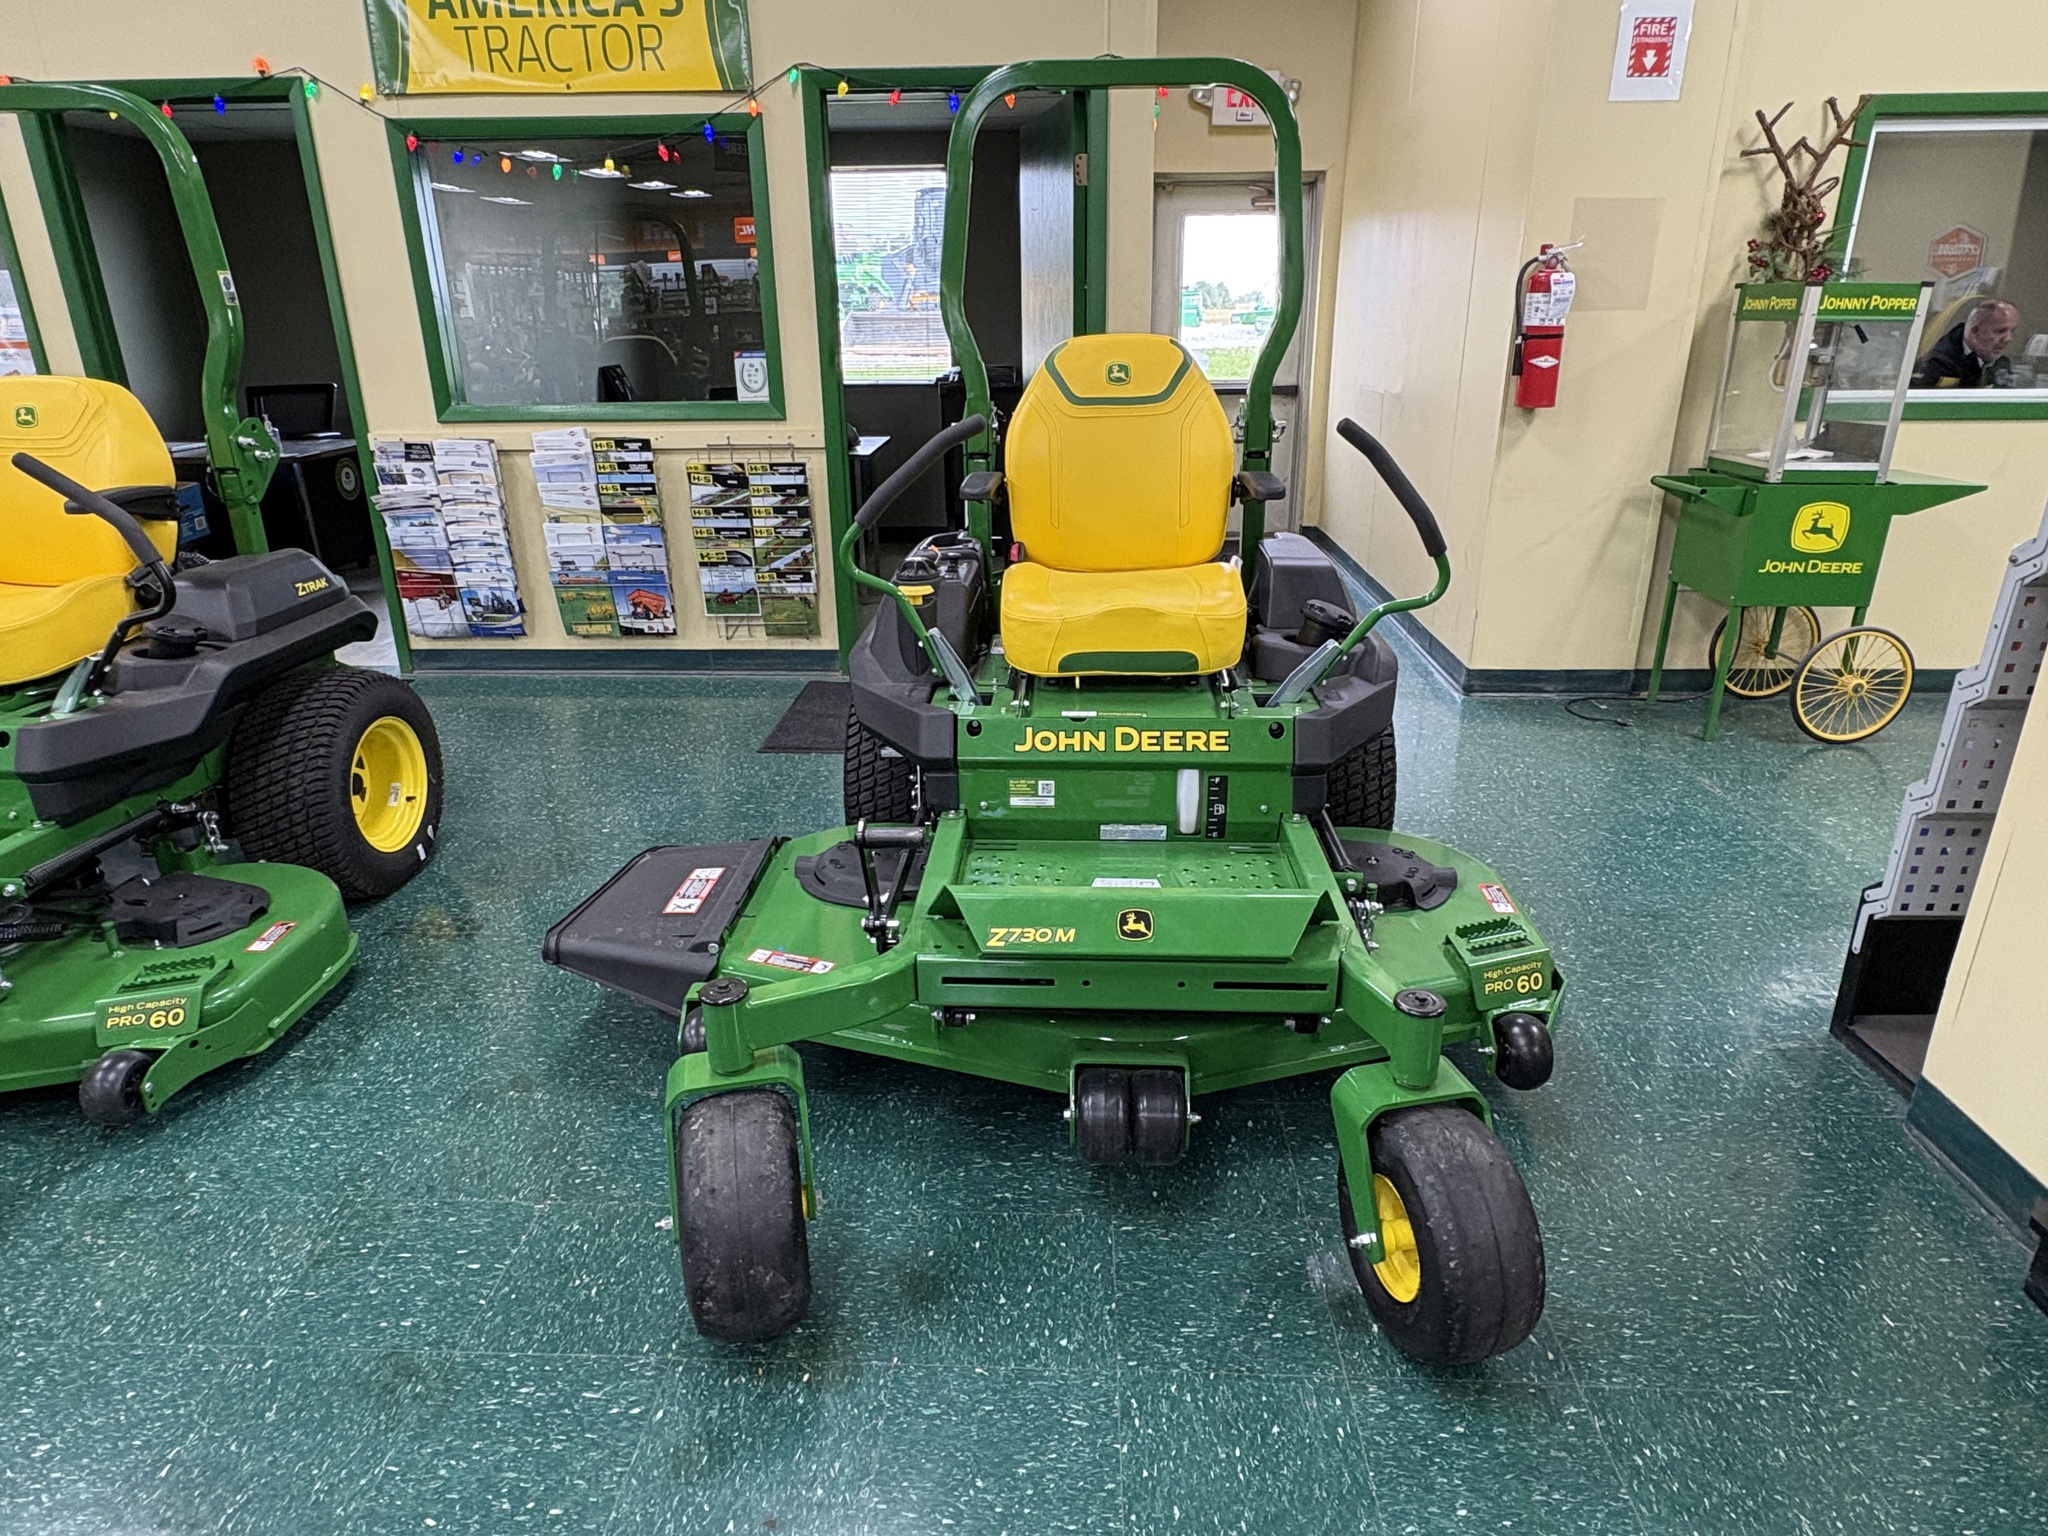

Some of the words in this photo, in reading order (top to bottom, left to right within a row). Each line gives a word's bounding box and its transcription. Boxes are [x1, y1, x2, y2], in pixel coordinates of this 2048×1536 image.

[1640, 23, 1669, 36] FIRE
[454, 24, 665, 74] TRACTOR
[1743, 296, 1768, 310] JOHNNY
[1769, 296, 1797, 310] POPPER
[1820, 295, 1869, 310] JOHNNY
[1869, 295, 1916, 310] POPPER
[1758, 559, 1805, 574] JOHN
[1806, 560, 1863, 574] DEERE
[294, 576, 329, 597] ZTRAK
[1014, 726, 1106, 752] JOHN
[1114, 726, 1230, 752] DEERE
[1483, 969, 1503, 979] High
[1504, 961, 1542, 974] Capacity
[1485, 978, 1514, 995] PRO
[1516, 972, 1543, 994] 60
[108, 1004, 134, 1014] High
[136, 998, 187, 1010] Capacity
[106, 1013, 146, 1030] PRO
[149, 1007, 185, 1029] 60
